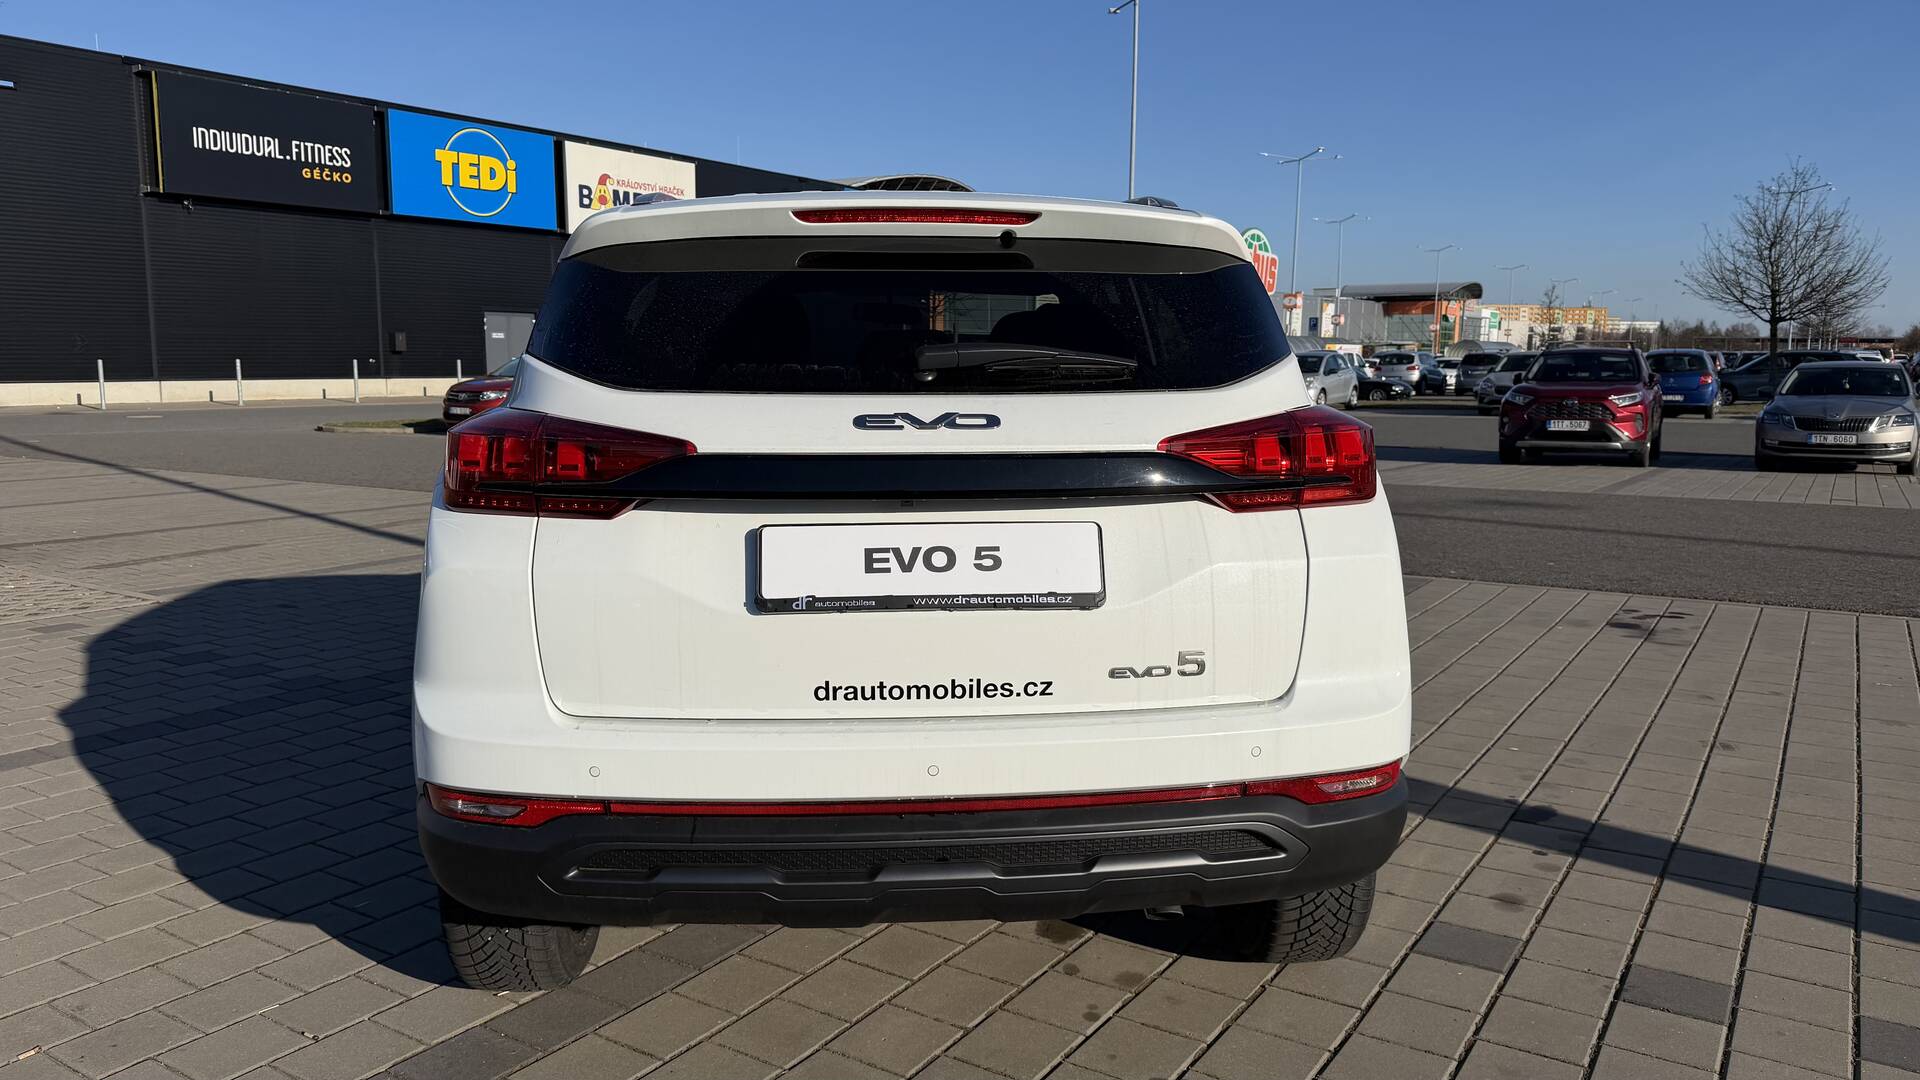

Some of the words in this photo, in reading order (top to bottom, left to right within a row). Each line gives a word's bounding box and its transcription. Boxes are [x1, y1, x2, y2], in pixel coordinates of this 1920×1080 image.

[302, 167, 352, 183] GÉČKO
[435, 149, 517, 194] TEDi
[616, 179, 658, 192] KRÁLOVSTVÍ
[658, 187, 685, 197] HRAČEK
[852, 412, 1001, 430] EVO
[864, 546, 957, 574] EVO
[973, 546, 1003, 572] 5
[814, 599, 876, 608] automobiles
[913, 594, 1073, 605] www.drautomobiles.cz
[1108, 664, 1172, 680] EVO
[1176, 650, 1206, 677] 5
[813, 678, 1054, 702] drautomobiles.cz
